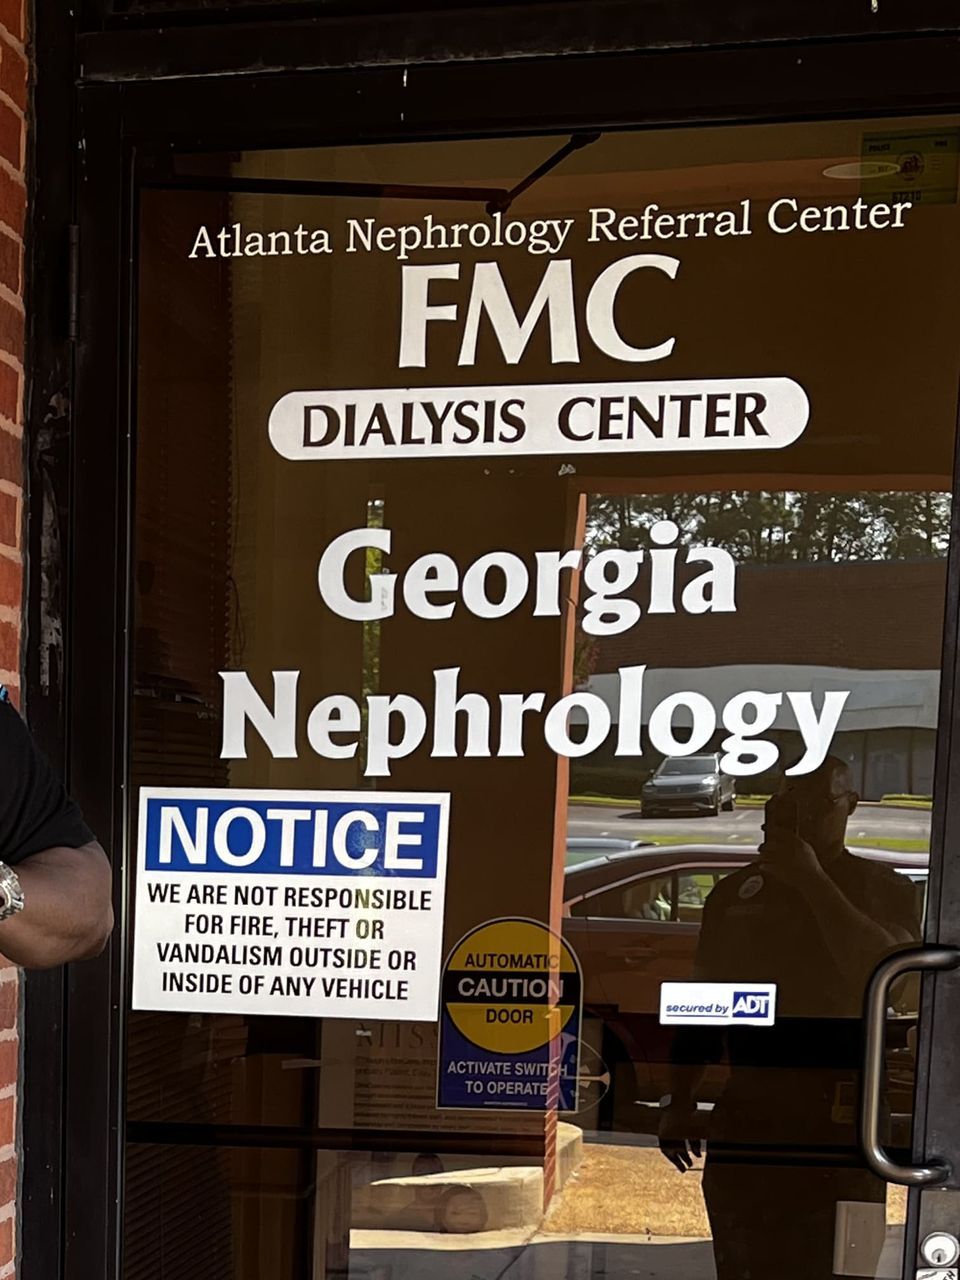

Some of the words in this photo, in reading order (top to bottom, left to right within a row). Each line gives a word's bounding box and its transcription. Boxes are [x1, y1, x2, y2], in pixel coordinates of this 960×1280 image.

[189, 222, 333, 259] Atlanta
[345, 211, 575, 261] Nephrology
[587, 199, 752, 242] Referral
[767, 197, 913, 234] Center
[396, 249, 681, 368] FMC
[302, 399, 526, 448] DIALYSIS
[557, 392, 769, 442] CENTER
[317, 517, 738, 636] Georgia
[218, 665, 850, 777] Nephrology
[158, 806, 425, 870] NOTICE
[147, 883, 181, 903] WE
[186, 884, 227, 905] ARE
[234, 885, 278, 906] NOT
[284, 887, 432, 911] RESPONSIBLE
[185, 913, 223, 935] FOR
[230, 915, 279, 939] FIRE,
[285, 917, 350, 938] THEFT
[356, 919, 384, 940] OR
[156, 942, 282, 966] VANDALISM
[289, 947, 381, 970] OUTSIDE
[388, 950, 416, 971] OR
[464, 953, 559, 969] AUTOMATIC
[162, 972, 232, 994] INSIDE
[239, 975, 265, 995] OF
[269, 976, 315, 997] ANY
[321, 977, 408, 1000] VEHICLE
[457, 977, 564, 998] CAUTION
[485, 1008, 534, 1024] DOOR
[666, 1004, 713, 1013] secured
[715, 1004, 729, 1015] by
[732, 993, 770, 1016] ADT
[447, 1060, 512, 1075] ACTIVATE
[514, 1062, 568, 1077] SWITCH
[465, 1080, 484, 1093] TO
[486, 1081, 549, 1096] OPERATE
